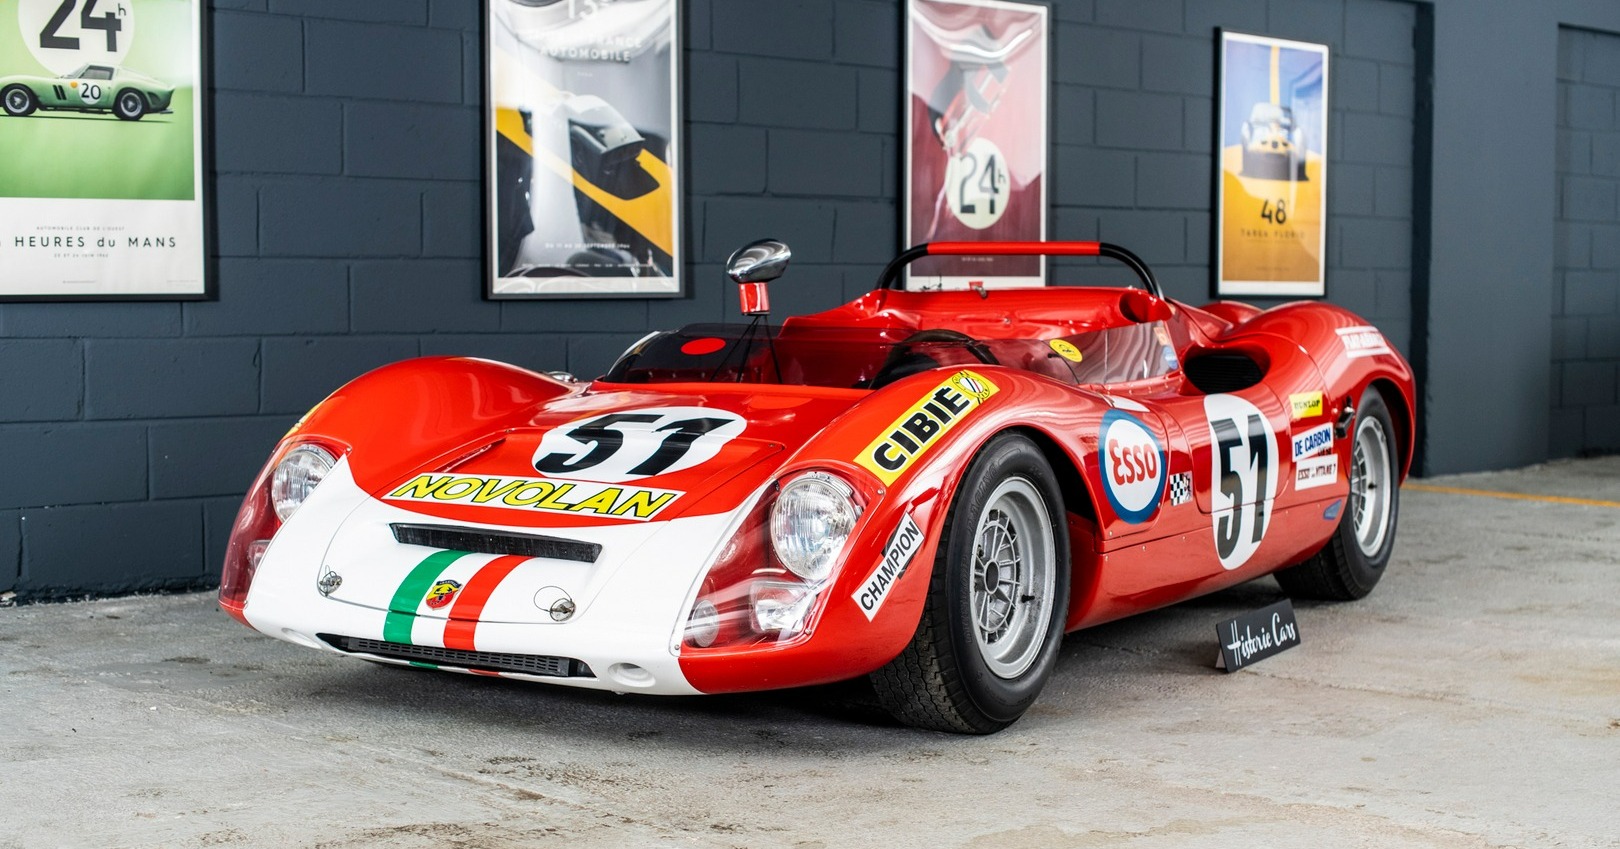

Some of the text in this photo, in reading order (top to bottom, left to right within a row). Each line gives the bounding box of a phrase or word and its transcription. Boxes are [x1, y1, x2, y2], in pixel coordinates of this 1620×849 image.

[81, 83, 101, 100] 20
[15, 236, 86, 247] HEURES
[97, 237, 116, 247] du
[128, 237, 176, 248] MANS
[1294, 400, 1320, 410] DUNLOP
[534, 413, 737, 476] 51
[1294, 441, 1303, 457] DE
[1305, 428, 1331, 452] CARBON
[390, 474, 677, 519] NOVOLAN
[1210, 413, 1269, 561] 51
[859, 519, 921, 612] CHAMPION
[1227, 612, 1296, 666] Historic Cars
